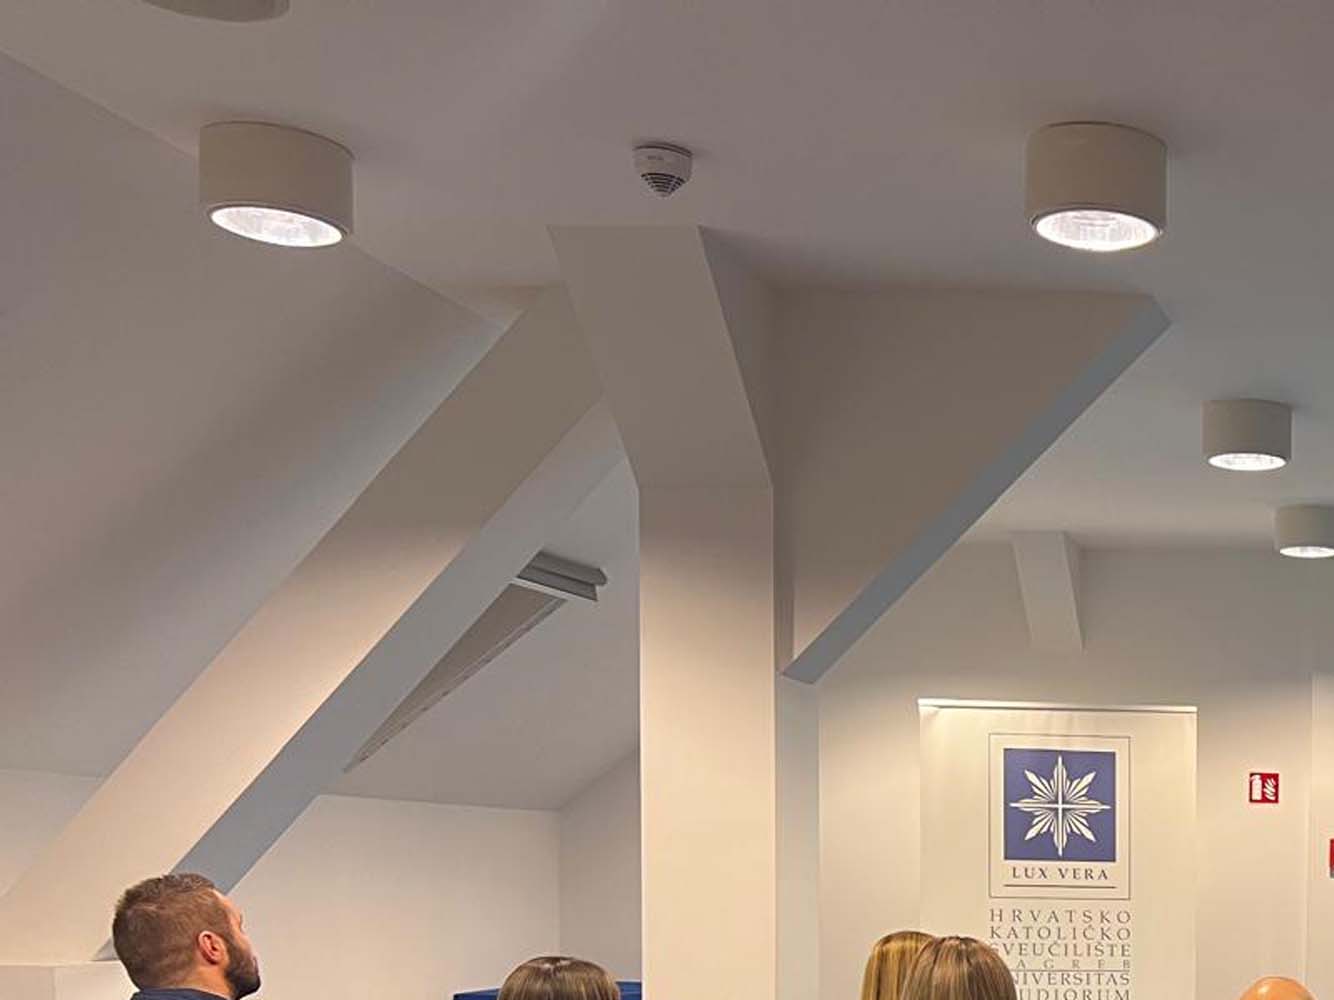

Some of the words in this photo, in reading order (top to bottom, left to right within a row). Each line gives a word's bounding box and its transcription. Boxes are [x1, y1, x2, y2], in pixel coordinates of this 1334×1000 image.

[1012, 866, 1048, 879] LUX
[1057, 867, 1109, 880] VERA
[990, 908, 1131, 924] HRVATSKO
[990, 924, 1131, 940] KATOLIČKO
[1016, 960, 1130, 969] AGREB
